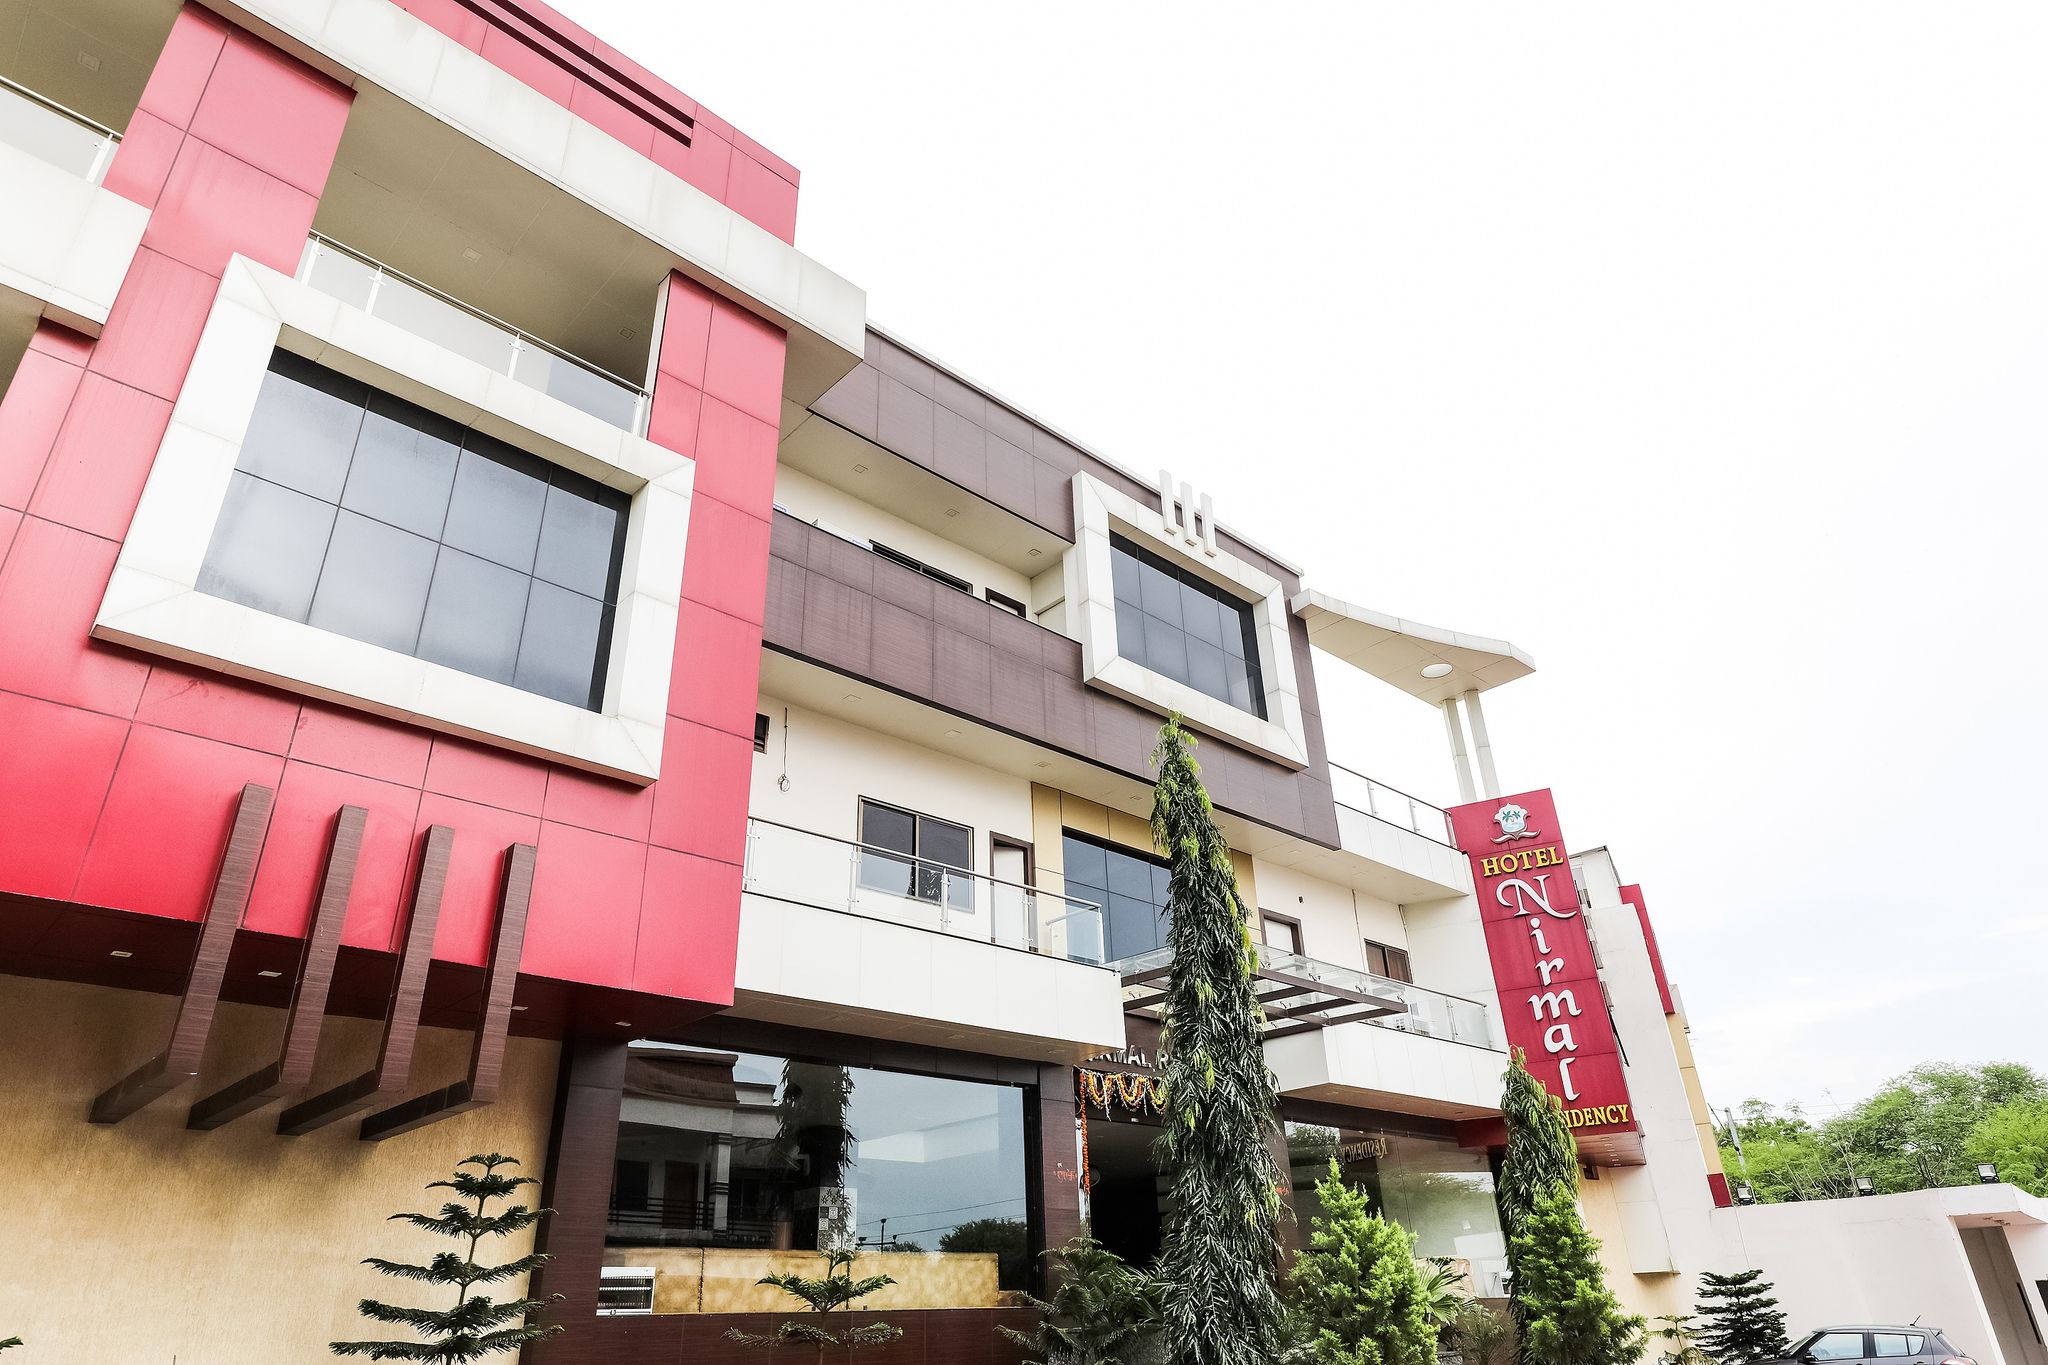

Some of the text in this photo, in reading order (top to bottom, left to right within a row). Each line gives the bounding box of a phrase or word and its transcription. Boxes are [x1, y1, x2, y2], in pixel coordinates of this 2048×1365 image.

[1480, 846, 1564, 876] HOTEL
[1495, 873, 1582, 1102] Nirmal
[1089, 1045, 1152, 1068] MAL
[1562, 1104, 1630, 1128] IDENCY
